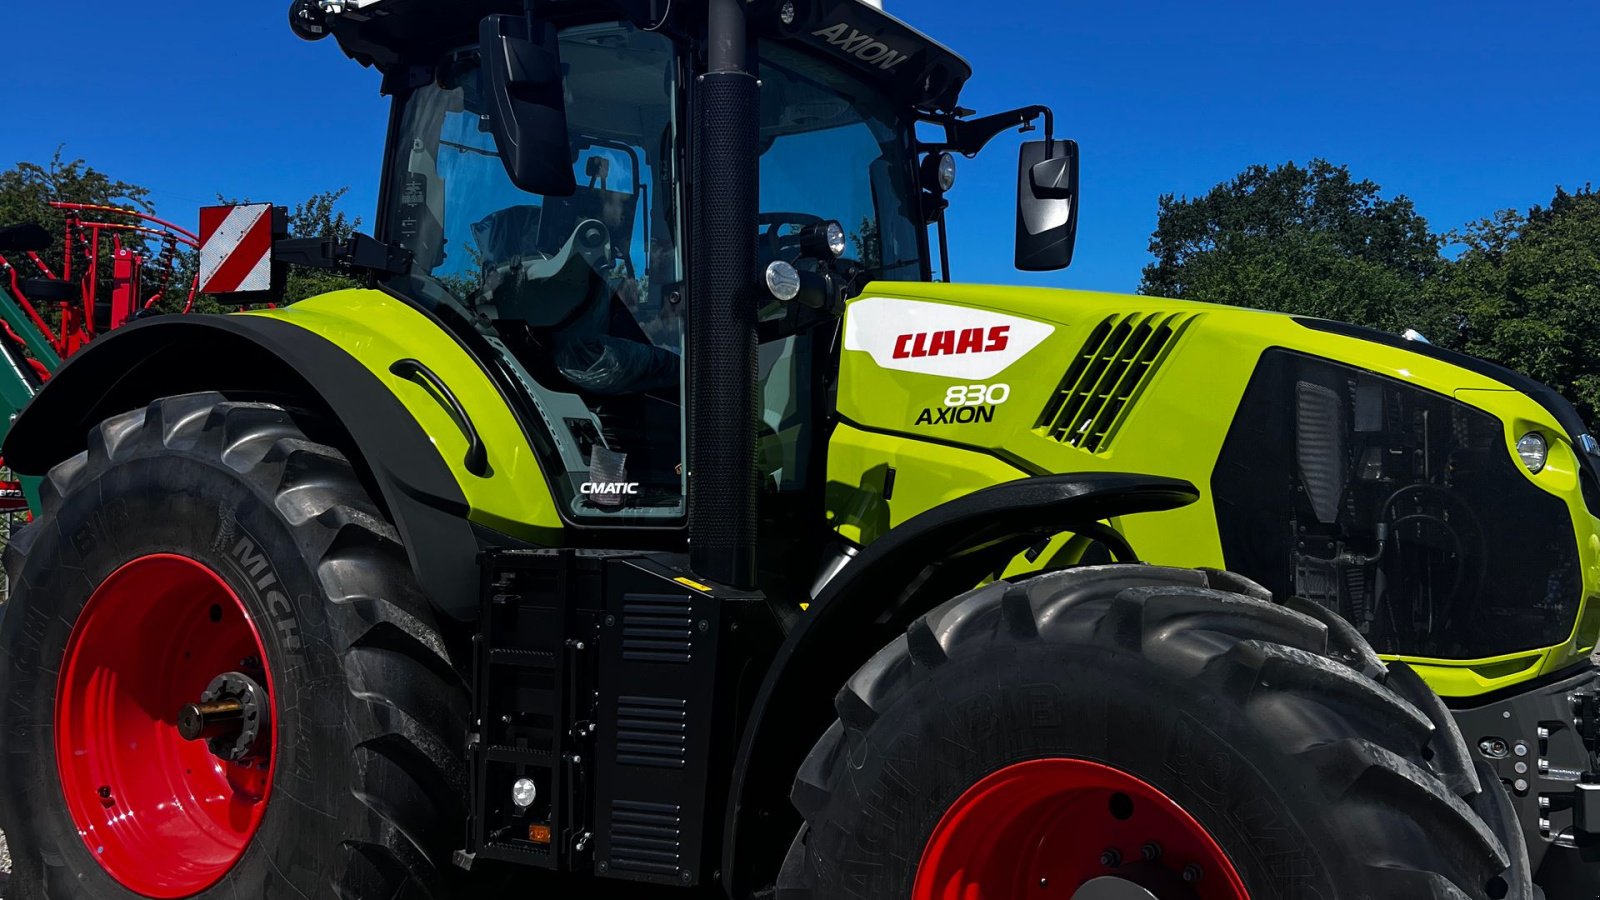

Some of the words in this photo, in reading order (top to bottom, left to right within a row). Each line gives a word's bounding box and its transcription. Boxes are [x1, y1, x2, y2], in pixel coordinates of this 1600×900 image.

[811, 22, 907, 70] AXION
[892, 325, 1010, 359] CLAAS
[943, 383, 1011, 407] 830
[914, 405, 995, 425] AXION
[580, 482, 639, 494] CMATIC
